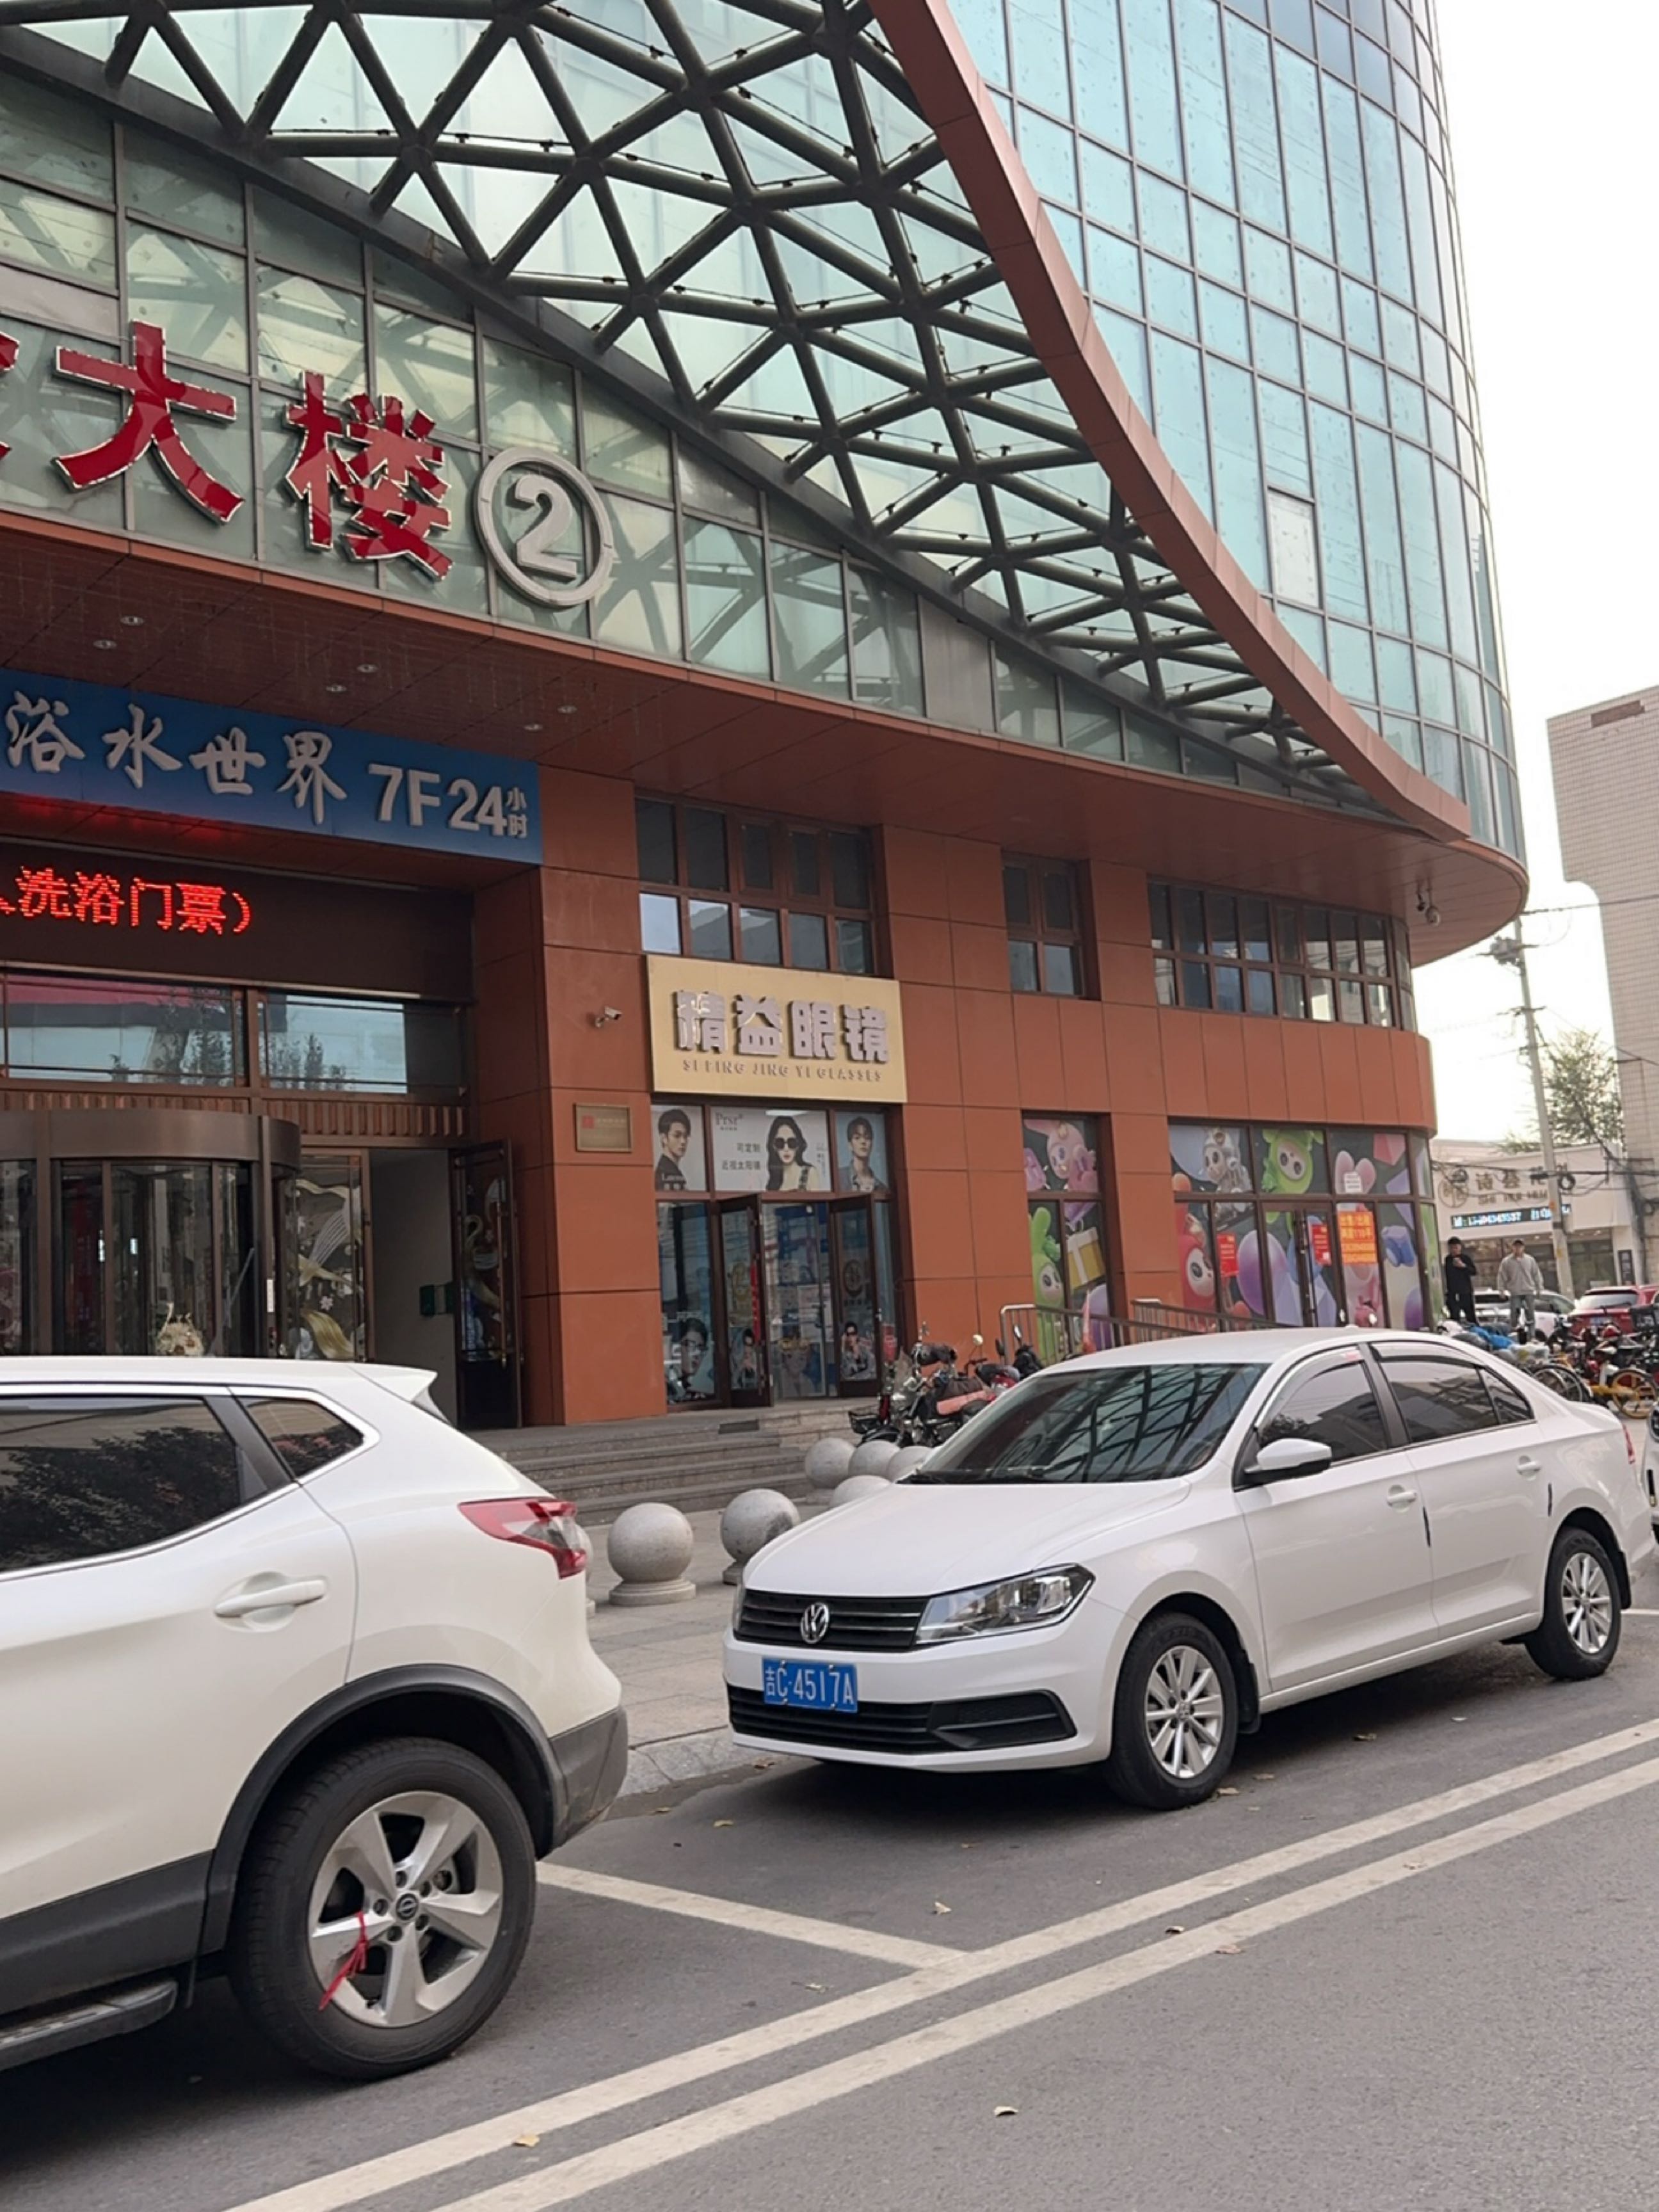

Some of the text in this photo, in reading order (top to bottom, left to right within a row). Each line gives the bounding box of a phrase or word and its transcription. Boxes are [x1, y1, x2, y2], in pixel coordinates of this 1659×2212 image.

[5, 691, 348, 825] 浴水世界
[368, 763, 441, 827] 7F
[672, 990, 890, 1064] 精益眼镜
